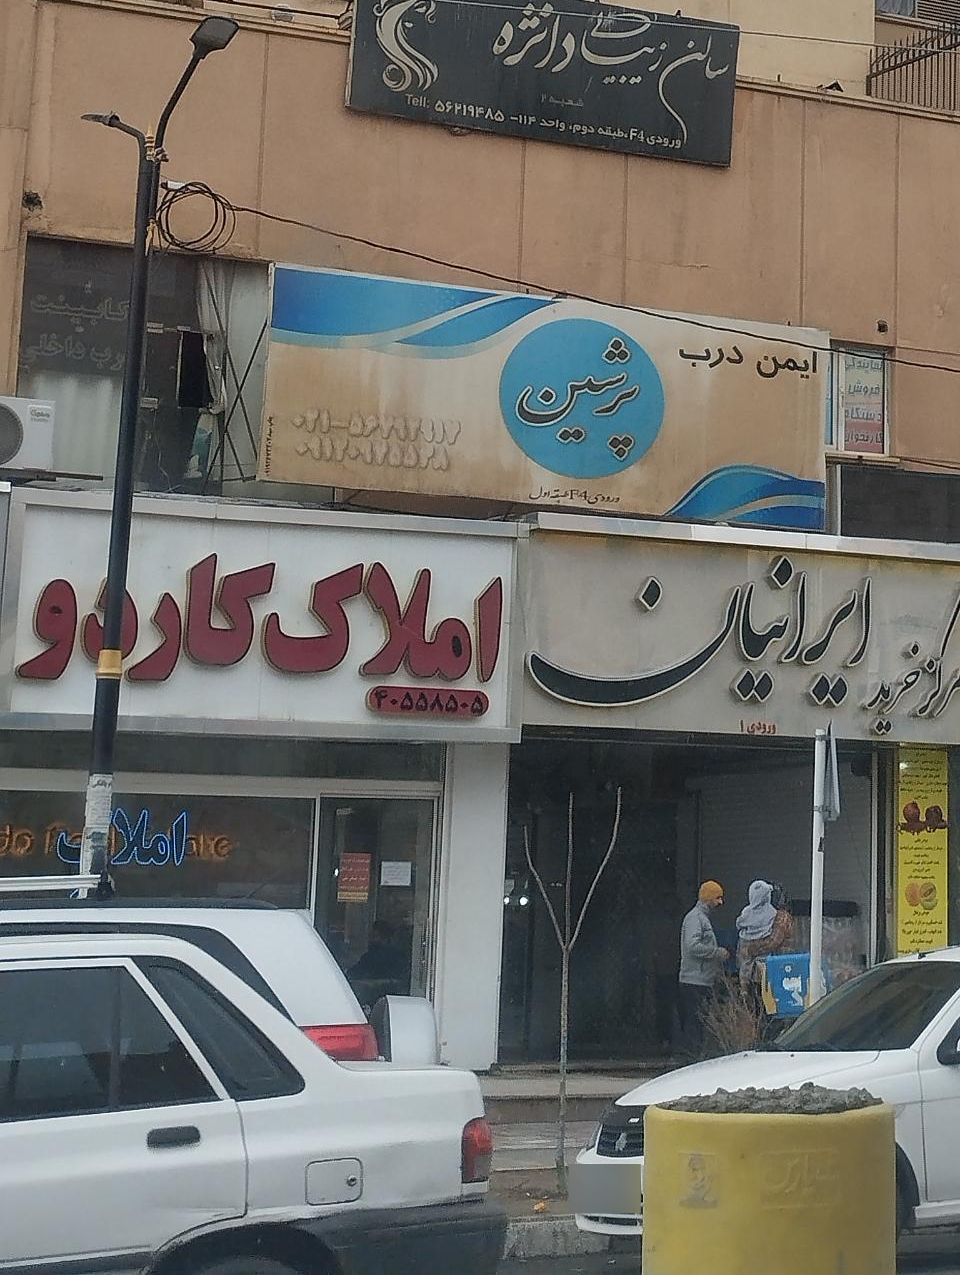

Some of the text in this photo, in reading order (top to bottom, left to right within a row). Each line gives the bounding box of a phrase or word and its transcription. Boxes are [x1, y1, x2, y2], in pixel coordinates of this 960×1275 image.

[580, 11, 668, 86] زیبایی
[658, 33, 730, 145] سالن
[539, 116, 566, 132] واحد
[645, 135, 682, 150] ورودی
[90, 346, 127, 371] رب
[678, 341, 818, 380] ایمن درب
[515, 337, 641, 460] پرشین
[528, 486, 550, 500] اول
[587, 493, 620, 505] ورودی
[262, 561, 503, 683] املاک
[527, 555, 873, 708] ایرانیان
[374, 688, 485, 715] ۴۰۵۵۸۵۰۵
[863, 642, 921, 735] خرید
[746, 720, 777, 735] ورودی
